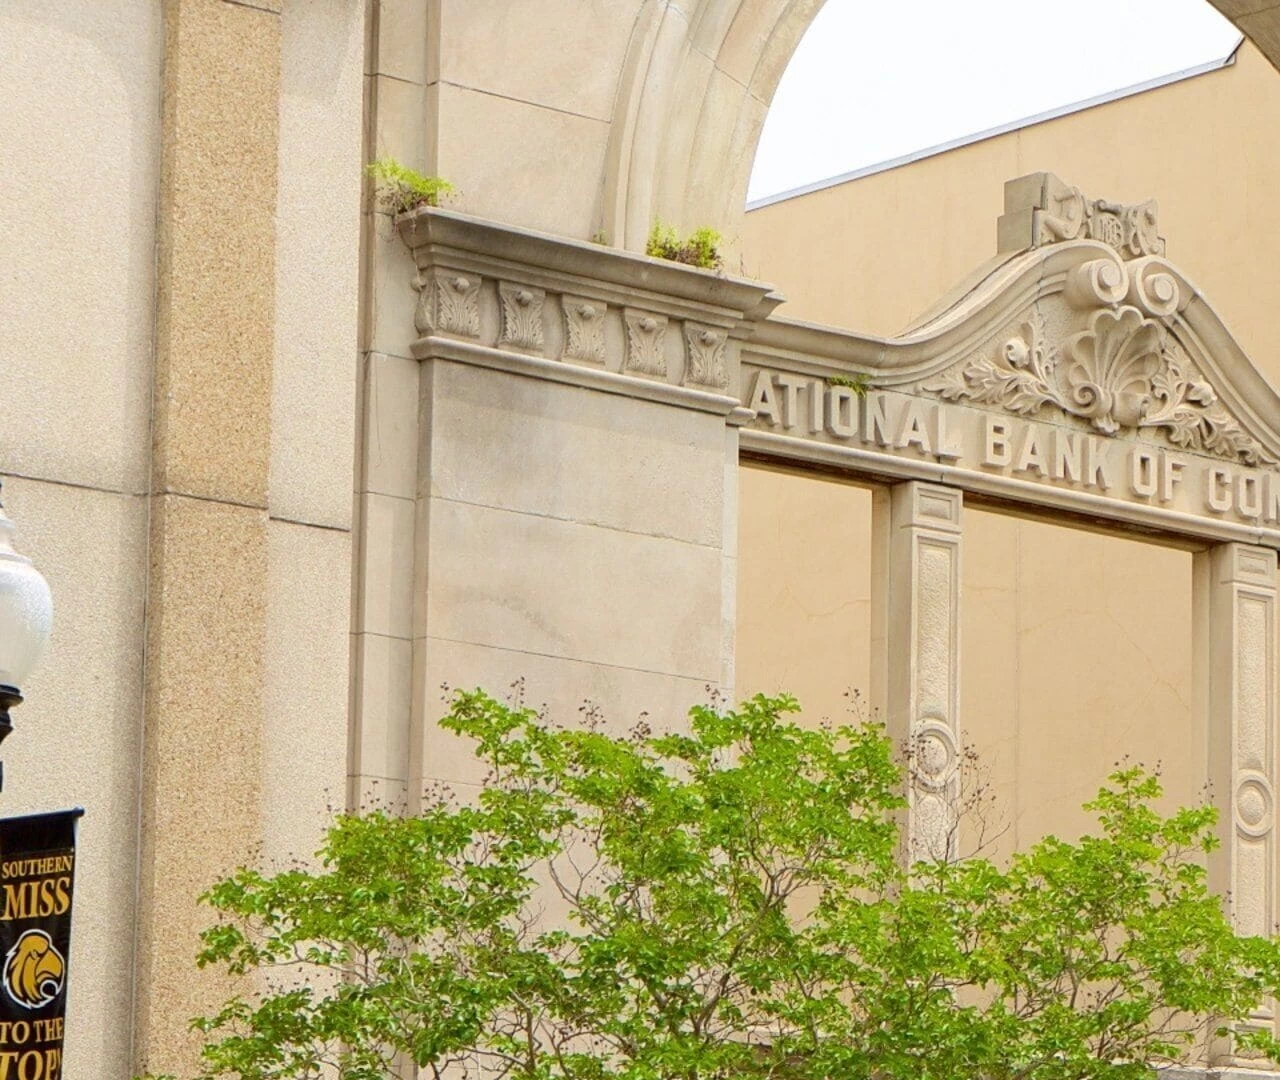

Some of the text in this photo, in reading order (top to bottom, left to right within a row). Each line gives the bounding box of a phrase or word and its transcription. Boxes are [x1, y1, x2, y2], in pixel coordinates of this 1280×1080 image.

[748, 369, 962, 459] ATIONAL
[981, 414, 1113, 490] BANK
[1130, 449, 1188, 502] OF
[2, 855, 74, 879] SOUTHERN
[0, 876, 71, 921] MISS
[0, 1016, 64, 1045] TO THE
